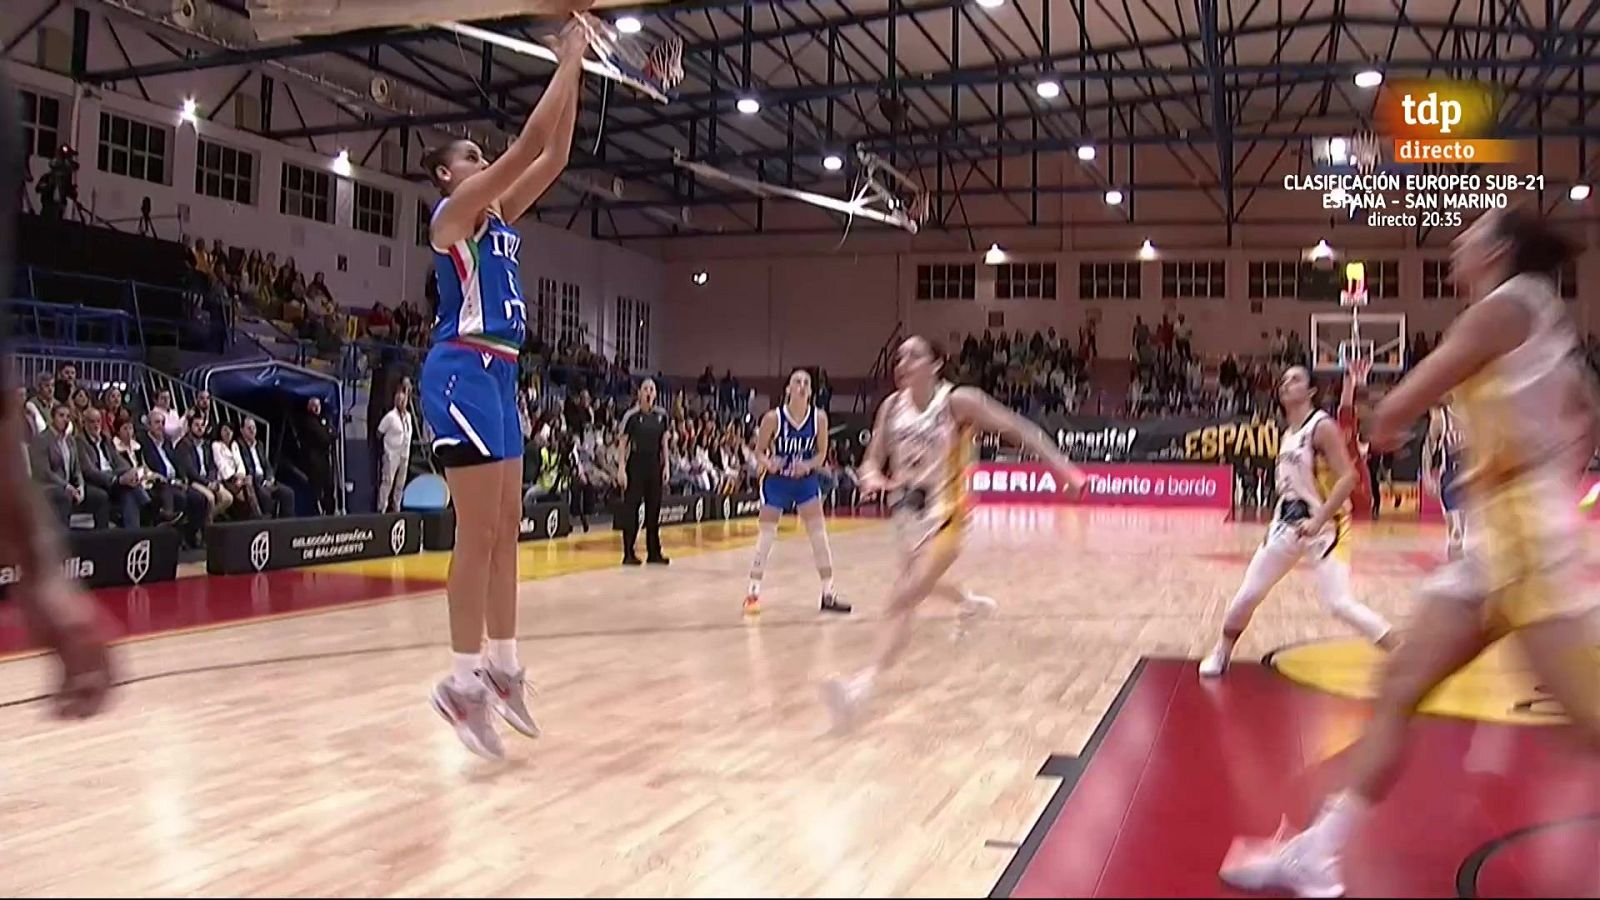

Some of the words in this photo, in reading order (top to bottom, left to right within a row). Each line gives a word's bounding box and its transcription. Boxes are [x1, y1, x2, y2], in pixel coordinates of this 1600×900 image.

[1185, 418, 1280, 460] ESPAÑ
[1087, 473, 1151, 496] Talento
[1154, 478, 1165, 496] a
[1168, 474, 1217, 497] bordo
